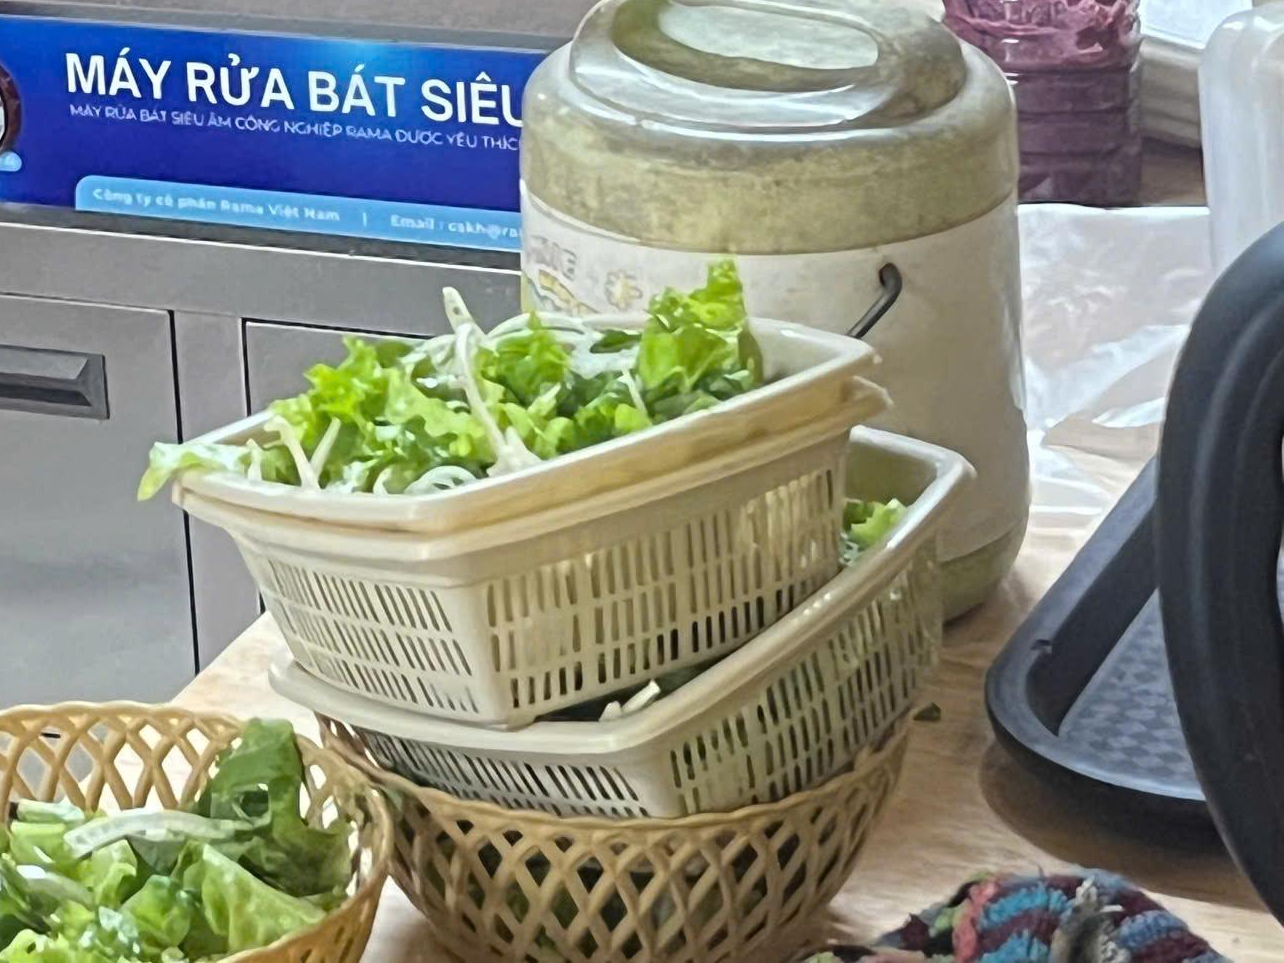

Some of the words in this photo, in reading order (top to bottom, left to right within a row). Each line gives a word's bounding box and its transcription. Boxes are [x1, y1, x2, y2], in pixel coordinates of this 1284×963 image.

[66, 47, 172, 99] MÁY
[186, 53, 295, 110] RỬA
[308, 64, 406, 118] BÁT
[421, 71, 524, 128] SIÊU
[234, 115, 281, 132] CÔNG
